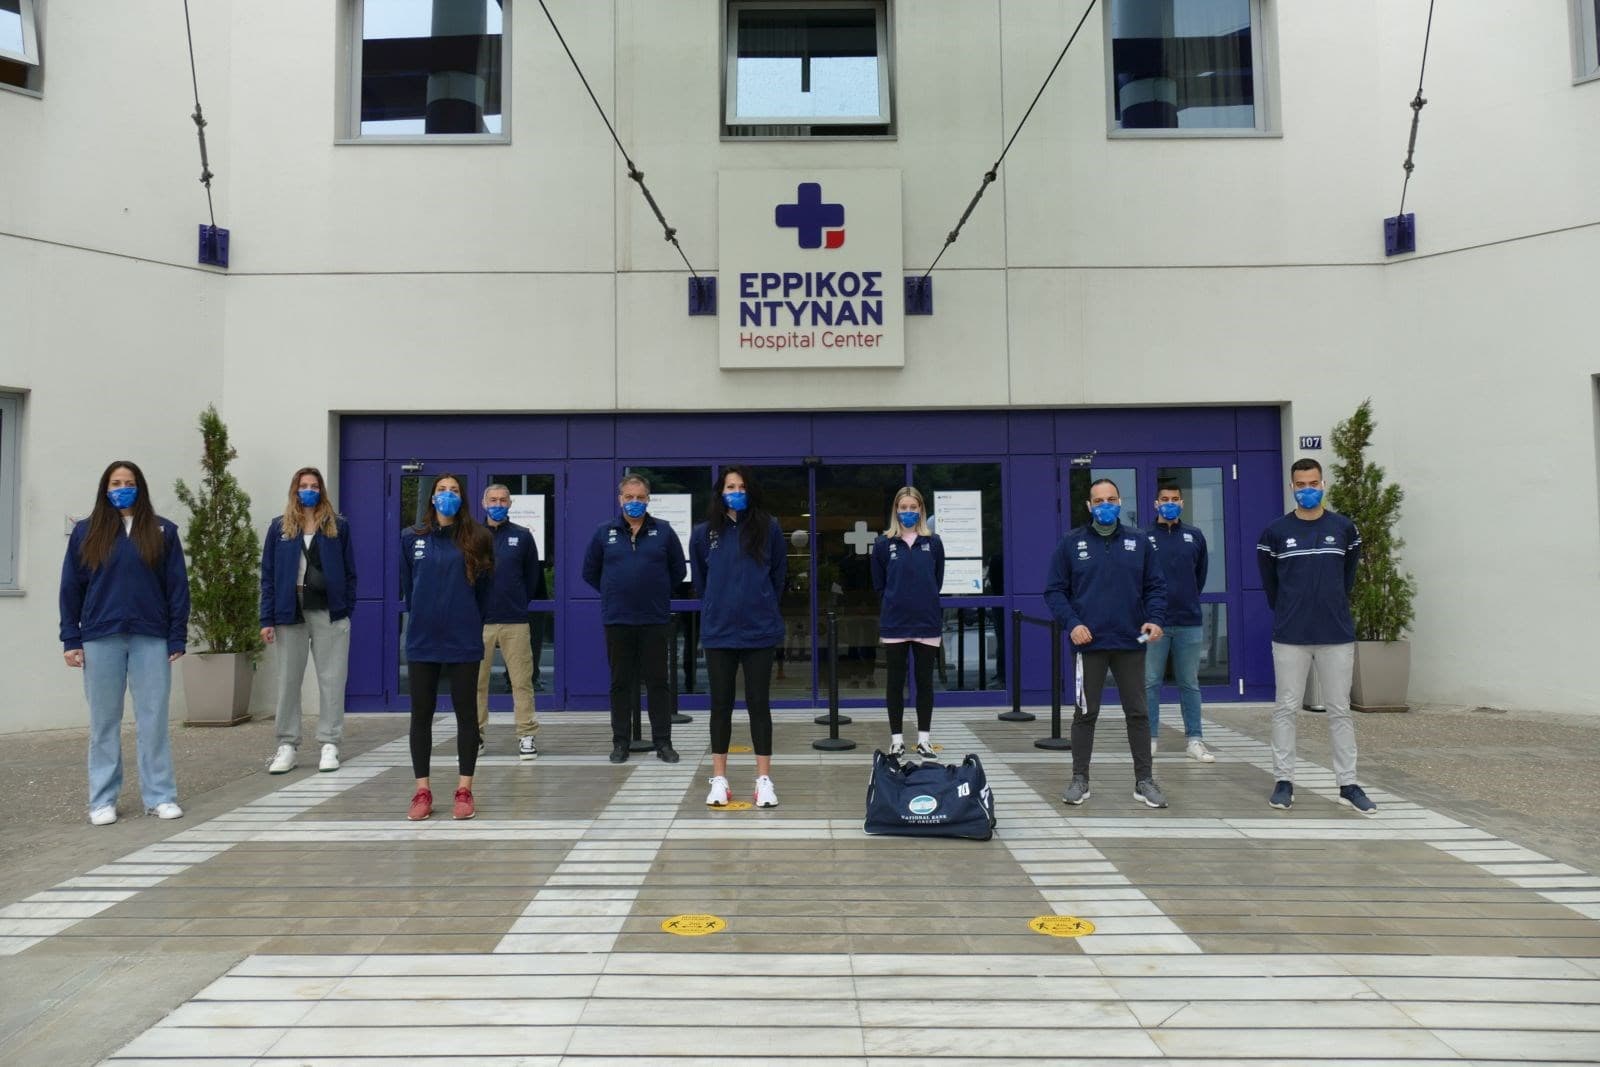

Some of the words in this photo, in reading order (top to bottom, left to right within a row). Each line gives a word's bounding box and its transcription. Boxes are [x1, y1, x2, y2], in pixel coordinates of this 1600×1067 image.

[739, 271, 883, 299] ΕΡΡΙΚΟΣ
[739, 300, 883, 327] ΝΤΥΝΑΝ
[739, 331, 815, 351] Hospital
[821, 331, 883, 348] Center
[1302, 437, 1320, 448] 107
